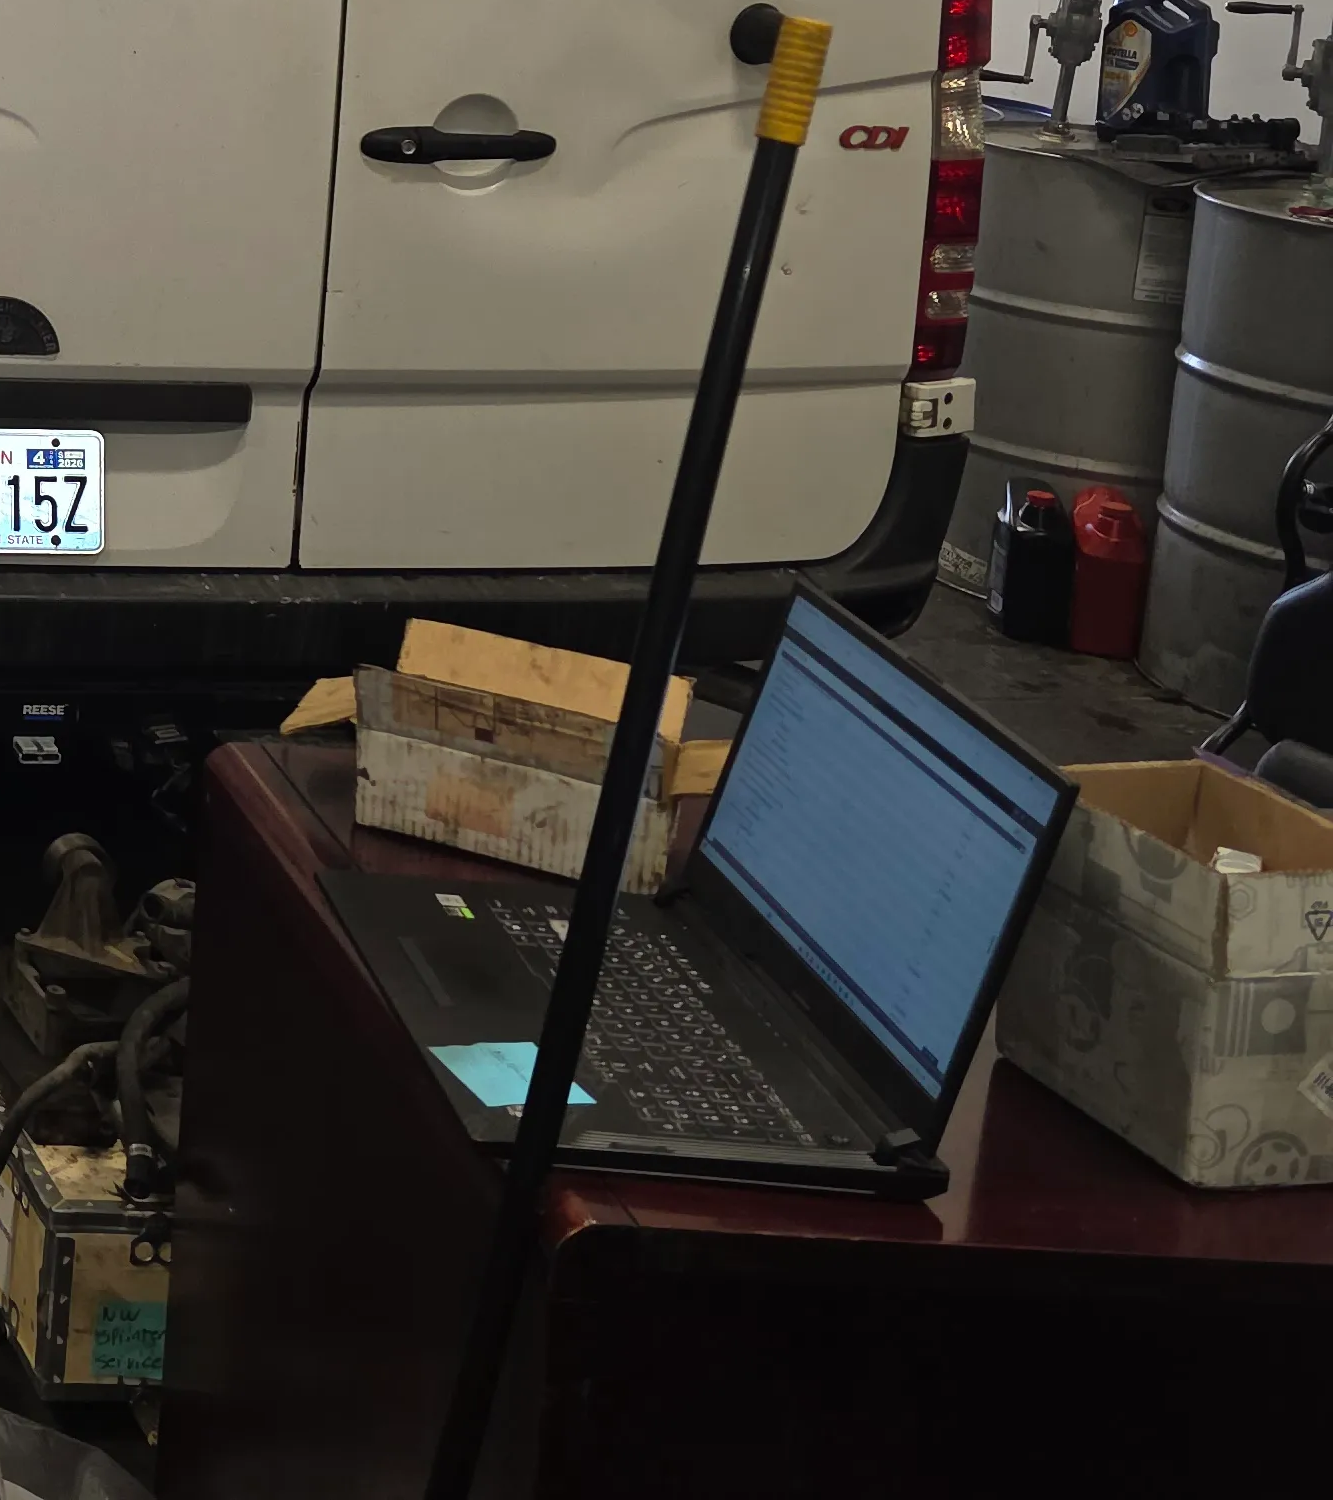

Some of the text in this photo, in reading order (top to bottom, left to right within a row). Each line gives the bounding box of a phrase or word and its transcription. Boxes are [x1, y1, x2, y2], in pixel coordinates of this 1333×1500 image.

[838, 125, 910, 150] CDI
[32, 450, 46, 465] 4
[7, 534, 44, 546] STATE
[23, 704, 65, 716] REESE
